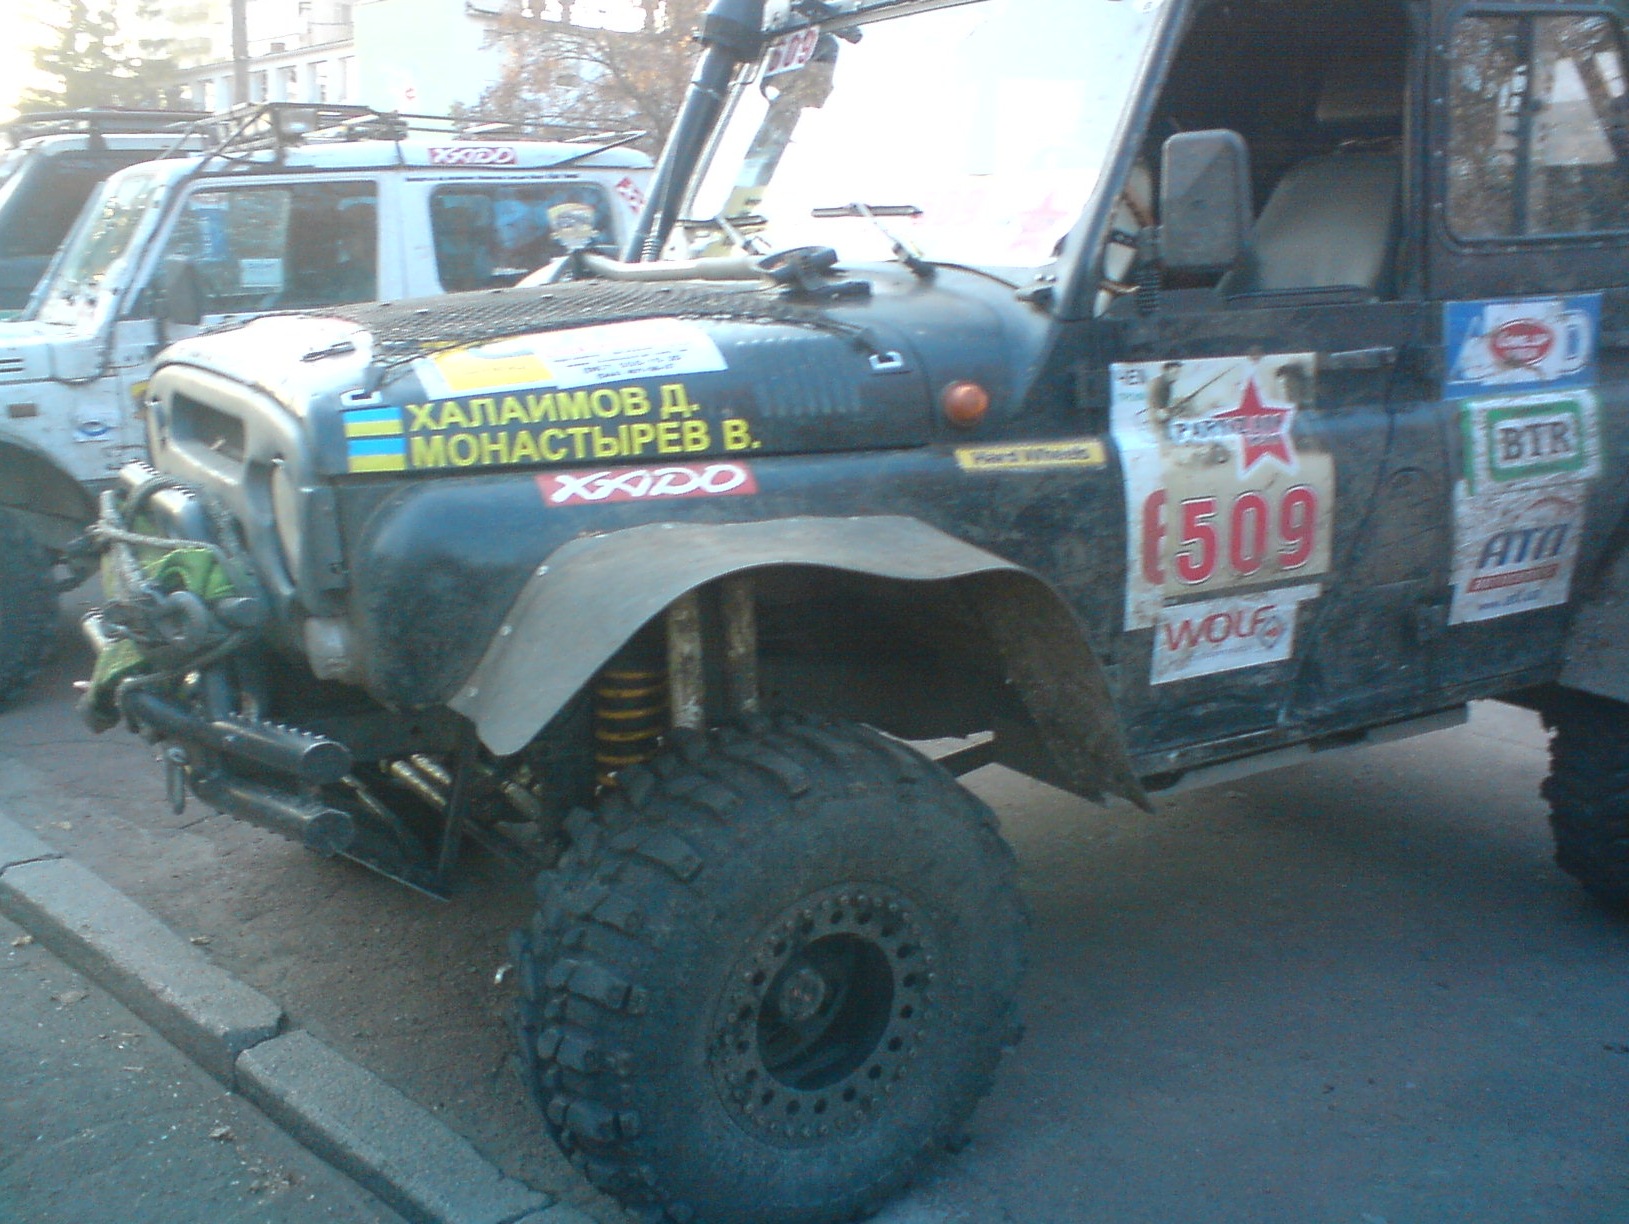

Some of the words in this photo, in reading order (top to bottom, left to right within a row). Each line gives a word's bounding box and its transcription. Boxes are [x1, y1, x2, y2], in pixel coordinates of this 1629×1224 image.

[406, 387, 652, 432] ХАЛАИМОВ
[659, 383, 700, 419] Д.
[410, 420, 711, 469] МОНАСТЫРЕВ
[722, 418, 762, 451] В.
[1498, 421, 1571, 461] BTR
[550, 464, 748, 503] XADO
[1163, 604, 1277, 651] WOLF
